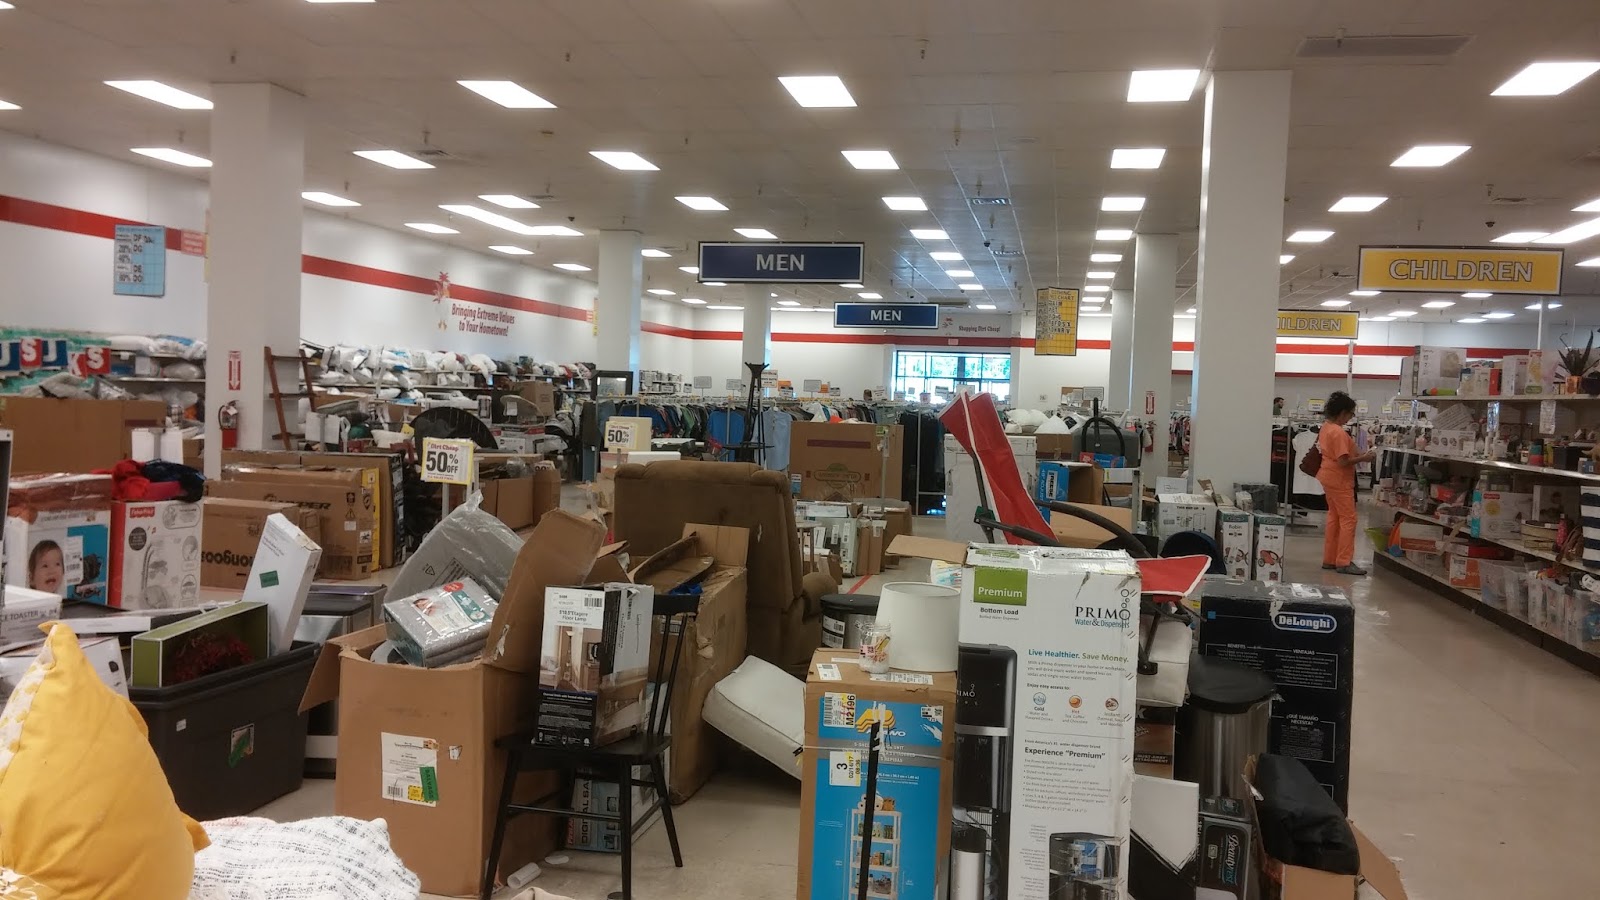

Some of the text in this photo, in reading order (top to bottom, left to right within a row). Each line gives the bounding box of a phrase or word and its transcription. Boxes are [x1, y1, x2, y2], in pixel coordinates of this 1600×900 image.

[756, 254, 805, 272] MEN
[1388, 259, 1533, 282] CHILDREN
[452, 303, 515, 324] Bringing Extreme Values
[870, 310, 902, 322] MEN
[458, 320, 509, 336] to Your Hometown!
[447, 466, 458, 474] OFF
[978, 586, 1022, 598] Premium
[10, 610, 38, 620] TOASTER
[1075, 606, 1130, 620] PRIMO
[1044, 650, 1080, 658] Healthier.
[1101, 654, 1129, 663] Money.
[846, 695, 855, 726] M2196
[1024, 746, 1064, 756] Experience
